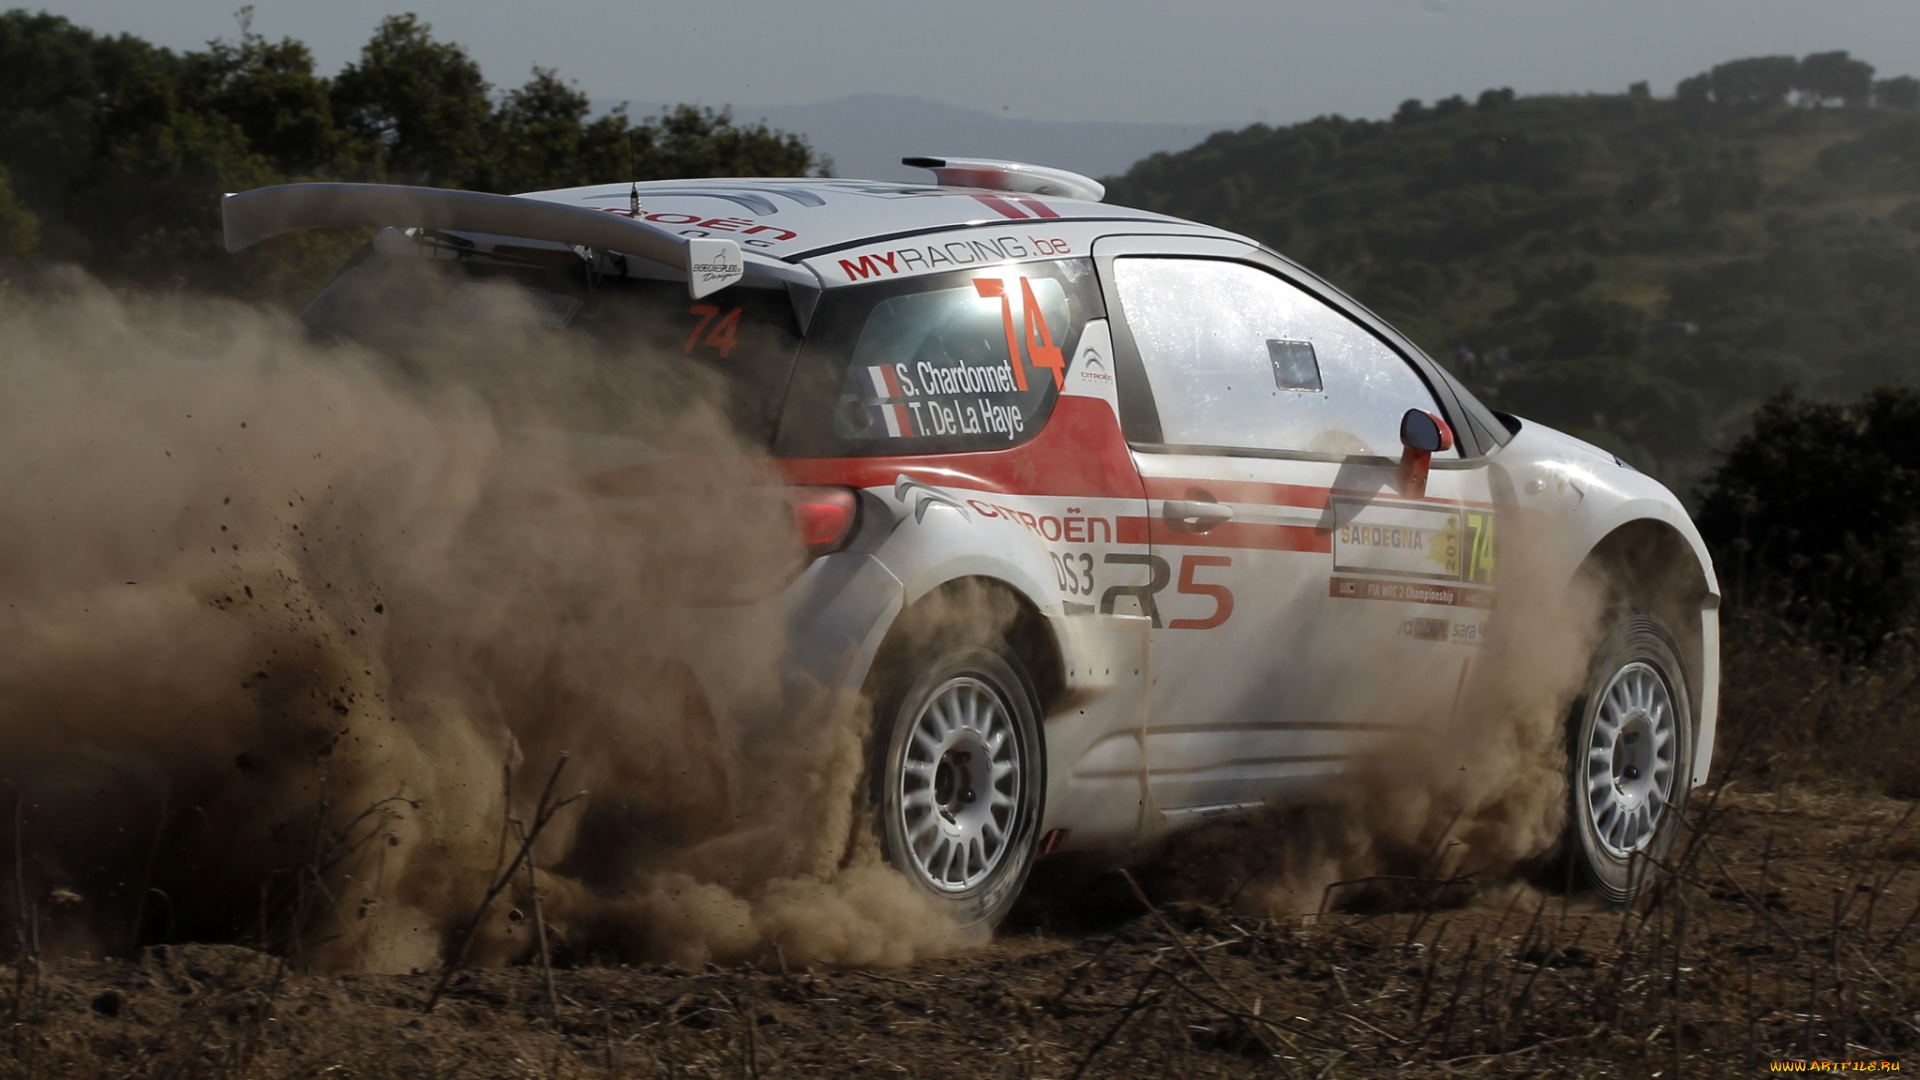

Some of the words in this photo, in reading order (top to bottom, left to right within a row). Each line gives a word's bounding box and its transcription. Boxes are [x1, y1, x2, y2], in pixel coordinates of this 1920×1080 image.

[838, 236, 1071, 281] MYRACING.be
[683, 305, 743, 358] 74
[972, 276, 1066, 391] 74
[895, 362, 919, 397] S.
[917, 359, 1018, 396] Chardonnet
[909, 402, 931, 437] T.
[935, 402, 957, 435] De
[959, 402, 981, 435] La
[983, 402, 1024, 440] Haye
[1341, 525, 1423, 550] SARDEGNA
[1467, 514, 1495, 584] 74
[1050, 551, 1094, 595] DS3
[1100, 553, 1235, 630] R5
[1368, 584, 1380, 596] FIA
[1382, 585, 1398, 598] WRC
[1399, 586, 1404, 598] 2
[1406, 586, 1454, 603] Championship
[1452, 622, 1476, 639] sara
